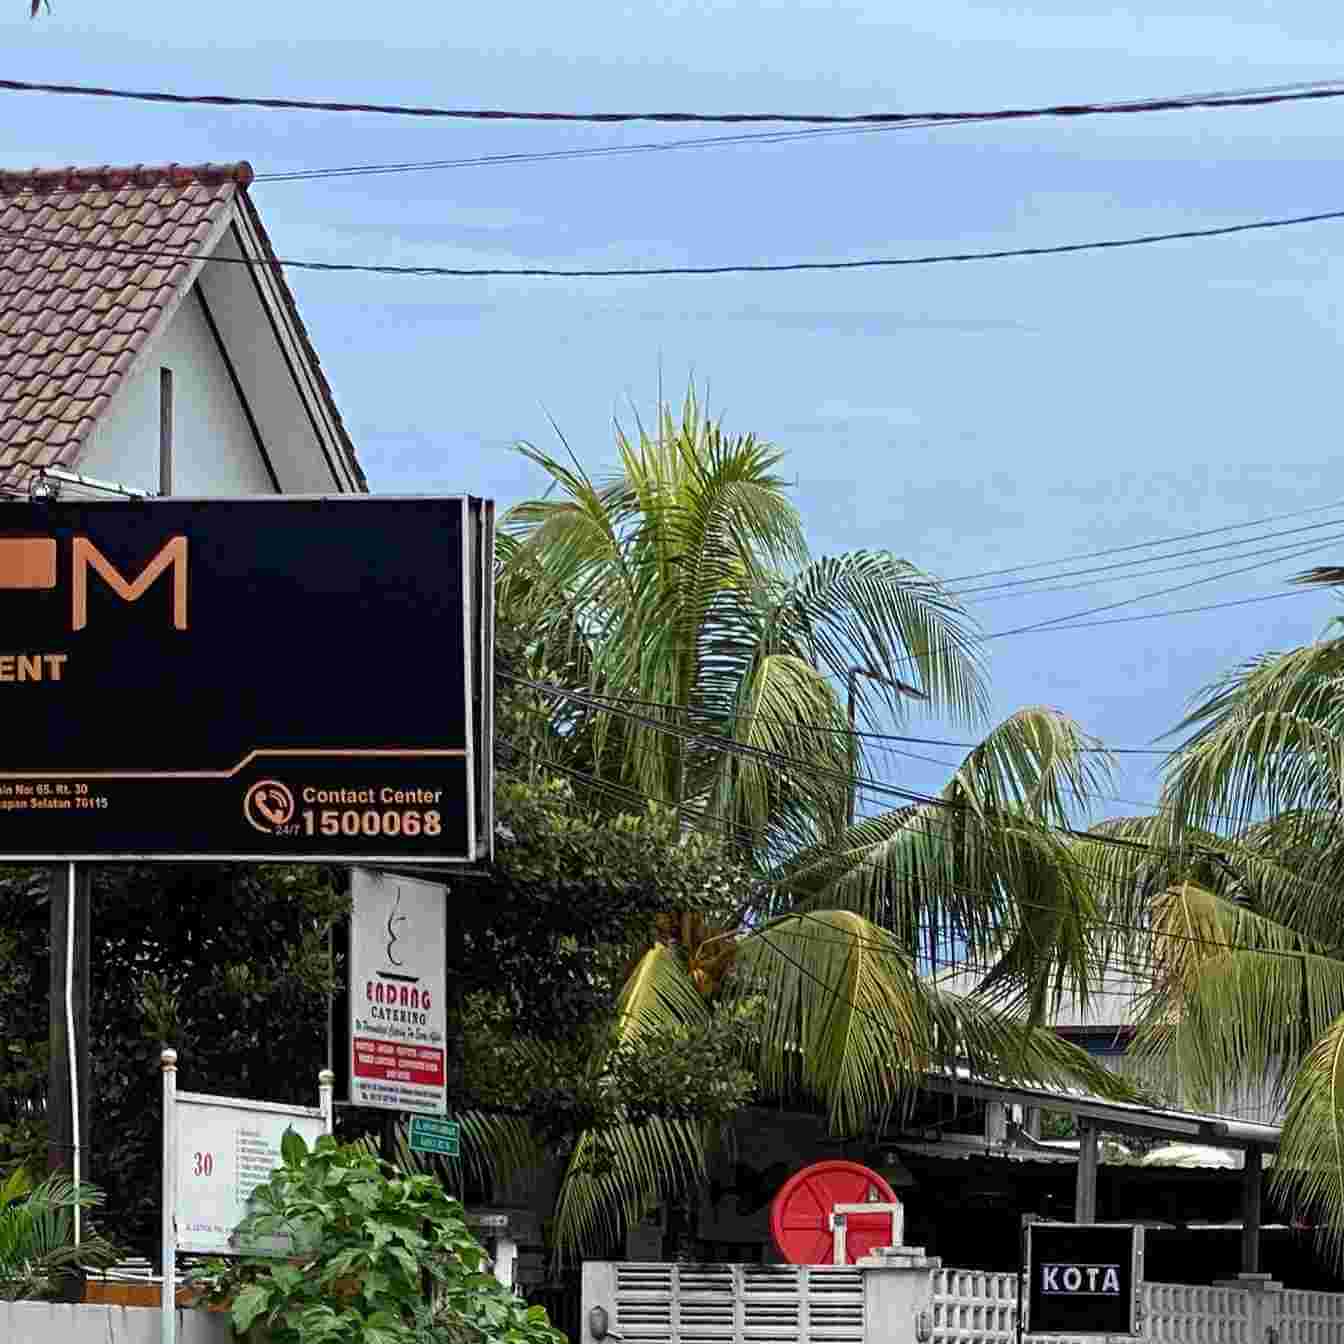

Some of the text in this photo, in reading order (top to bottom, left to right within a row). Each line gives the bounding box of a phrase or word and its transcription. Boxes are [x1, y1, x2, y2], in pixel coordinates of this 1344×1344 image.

[303, 787, 442, 804] Contact Center
[302, 810, 443, 836] 1500068
[371, 1006, 427, 1026] CATERING
[193, 1151, 214, 1177] 30
[1042, 1266, 1120, 1292] KOTA
